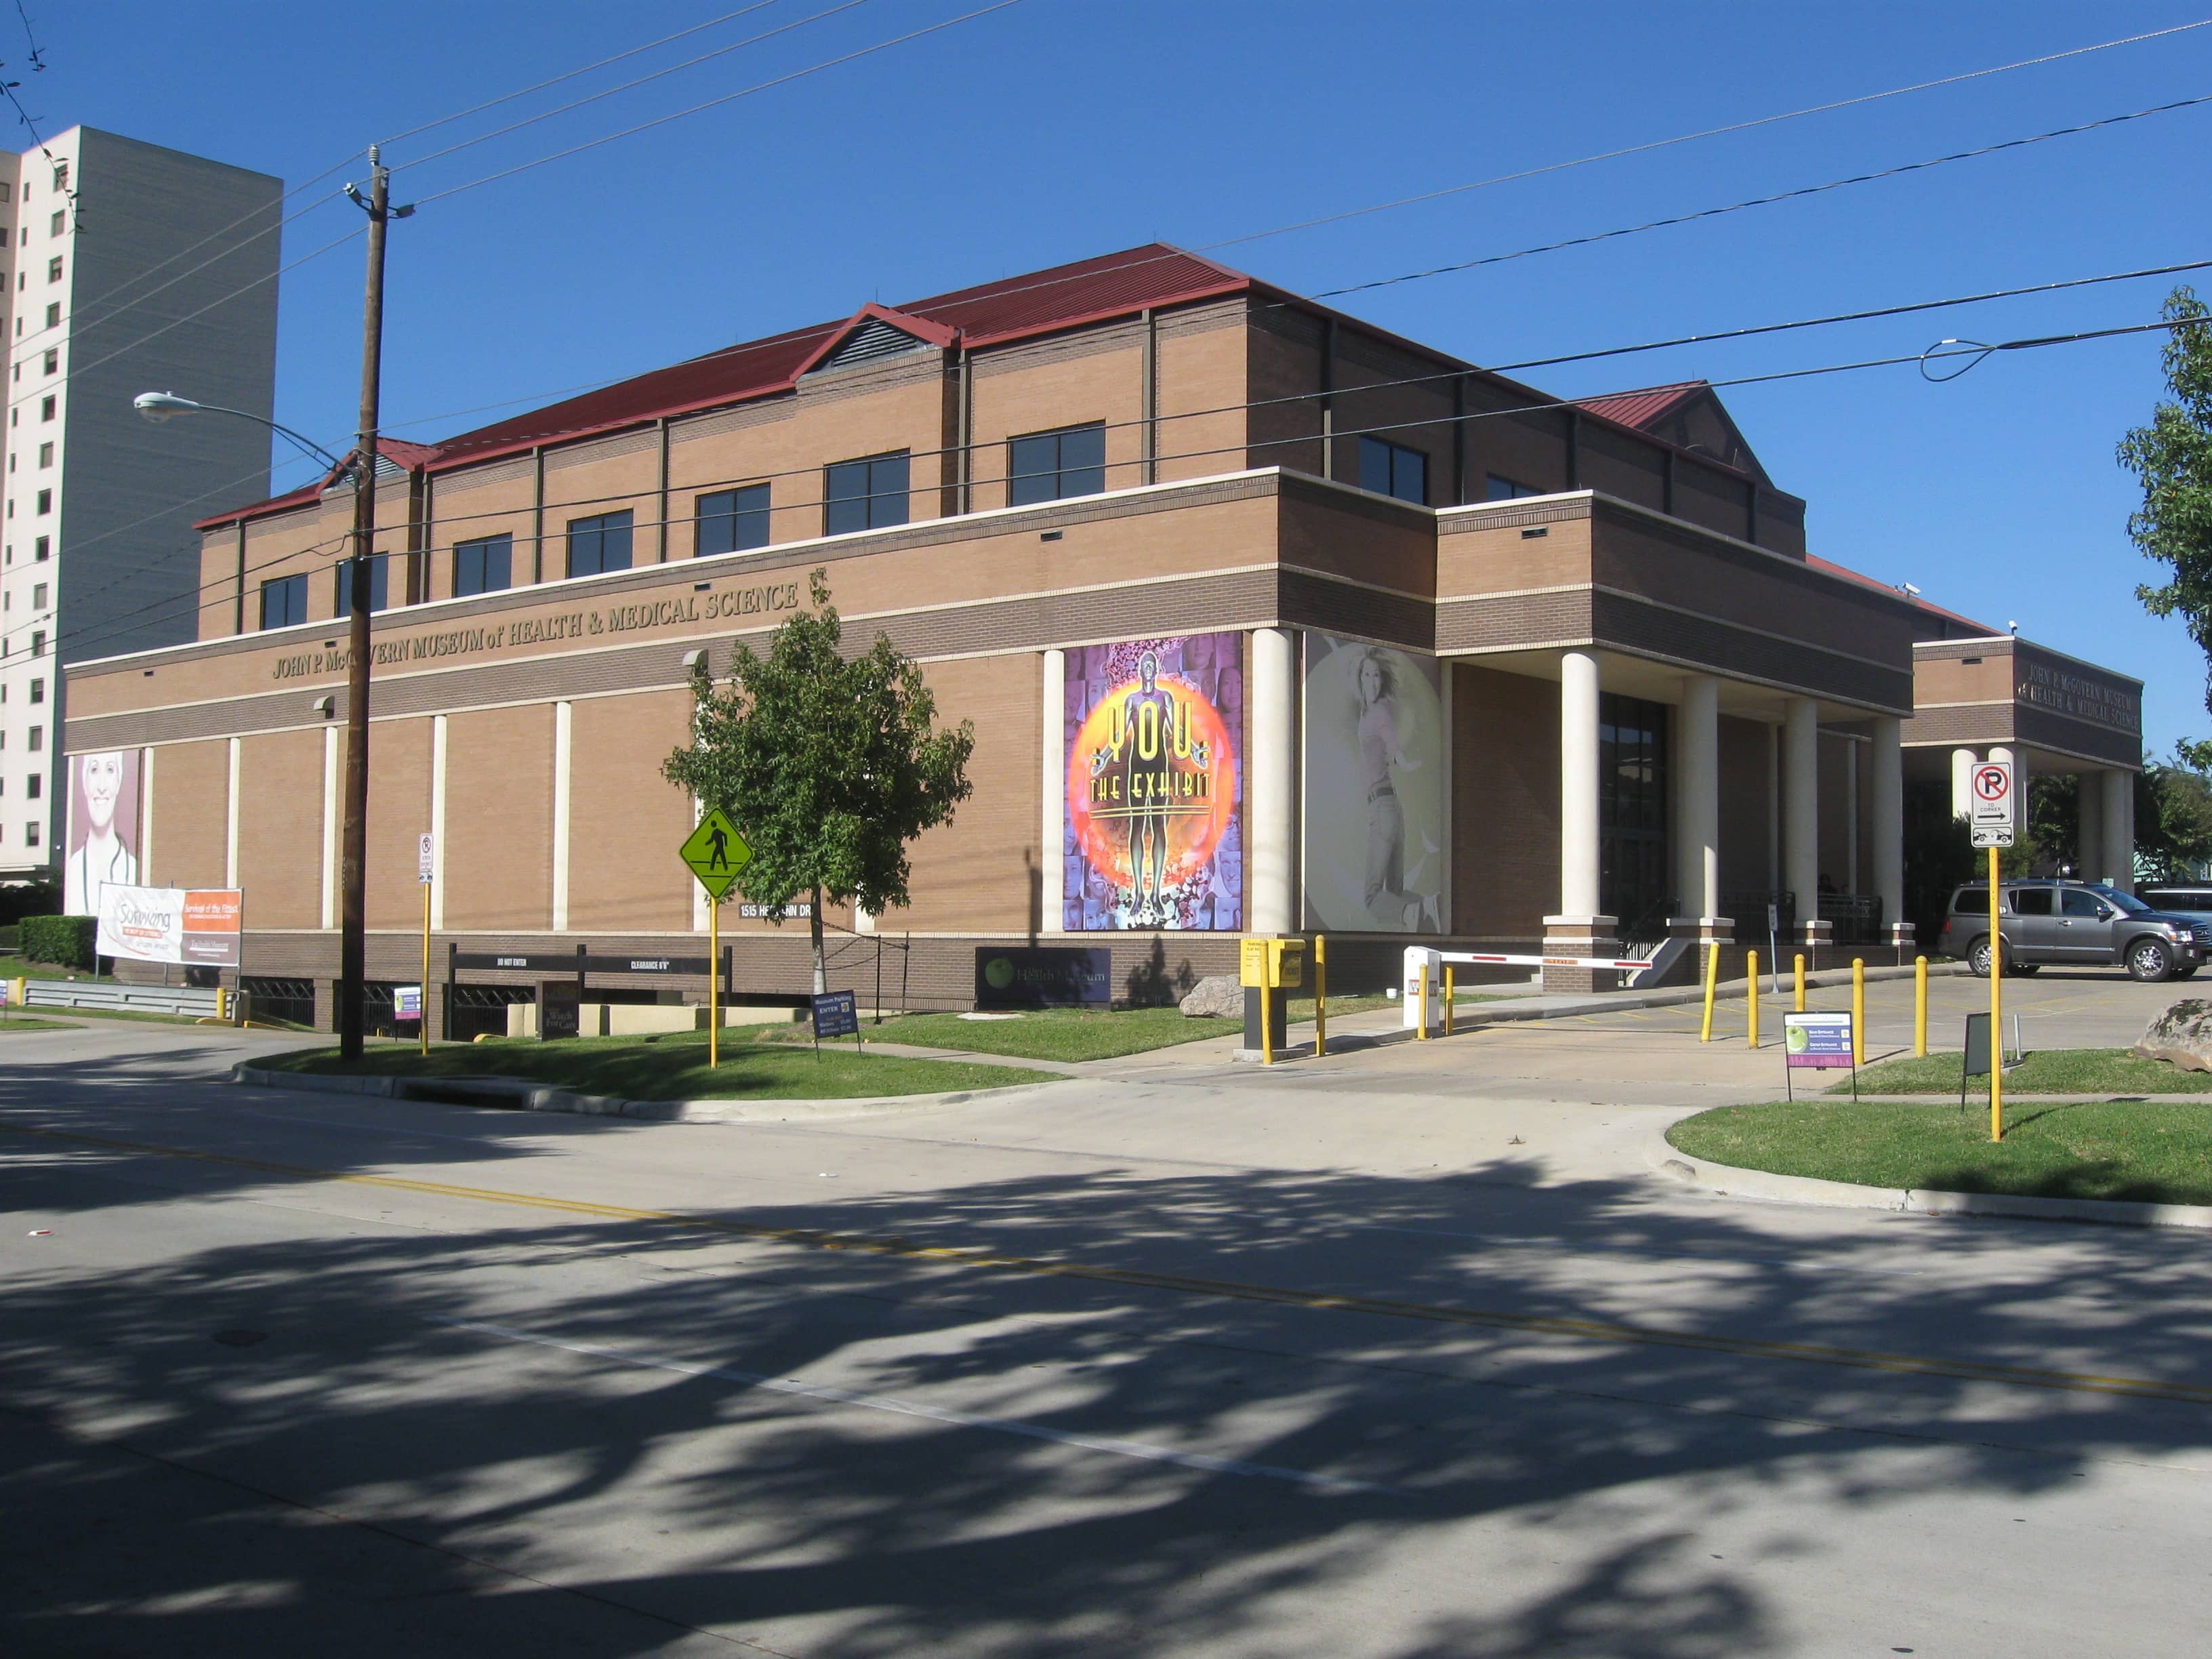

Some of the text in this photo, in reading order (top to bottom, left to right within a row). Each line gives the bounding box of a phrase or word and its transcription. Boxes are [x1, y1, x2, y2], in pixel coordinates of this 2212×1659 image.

[272, 654, 311, 678] JOHN
[314, 654, 323, 673] P.
[413, 628, 484, 659] MUSEUM
[487, 626, 504, 648] of
[508, 613, 583, 646] HEALTH
[588, 611, 603, 634] &
[609, 597, 699, 632] MEDICAL
[705, 582, 798, 619] SCIENCE
[2028, 664, 2049, 684] JOHN
[2061, 674, 2100, 700] McGOVERN
[2104, 688, 2131, 711] MUSEUM
[2030, 684, 2062, 709] HEALTH
[2066, 695, 2072, 711] &
[2076, 698, 2108, 720] MEDICAL
[2111, 708, 2137, 730] SCIENCE
[1090, 771, 1210, 802] THE EXHIBIT
[741, 905, 757, 917] 1515
[513, 958, 527, 966] ENTER
[631, 960, 658, 969] CLEARANCE
[548, 1010, 573, 1021] Watch
